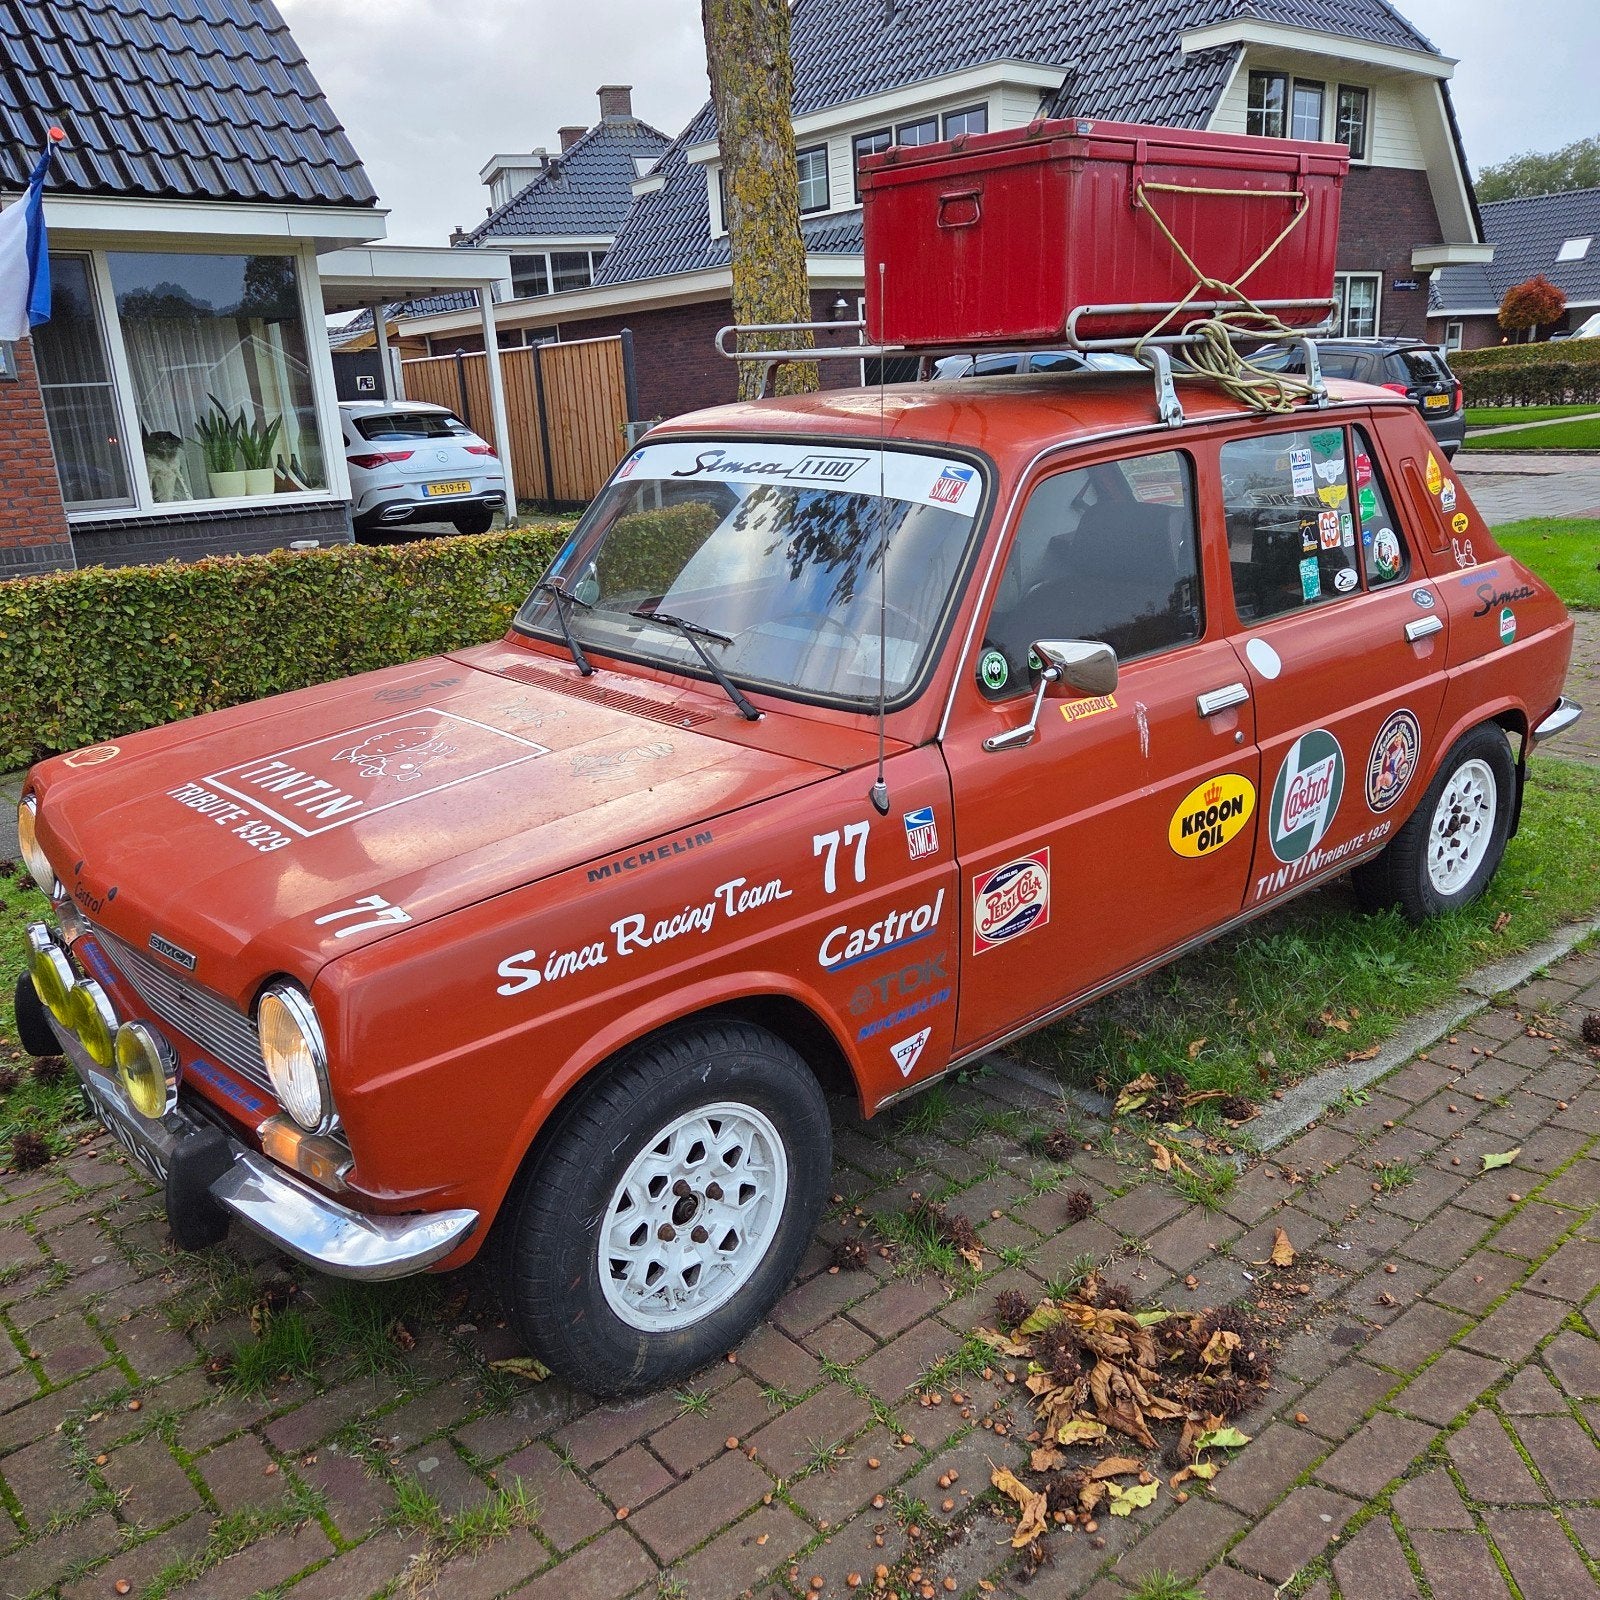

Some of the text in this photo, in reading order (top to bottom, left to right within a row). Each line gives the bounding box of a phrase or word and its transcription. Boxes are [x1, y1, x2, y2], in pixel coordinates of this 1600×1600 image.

[671, 449, 855, 477] Simca 1100
[930, 478, 966, 502] SIMCA
[1473, 583, 1535, 618] Simca
[240, 760, 364, 819] TINTIN
[1182, 793, 1244, 839] KROON
[1283, 759, 1334, 833] Castrol
[166, 782, 292, 852] TRIBUTE 1929
[907, 825, 938, 857] SIMCA
[1197, 824, 1224, 851] OIL
[586, 830, 714, 883] MICHELIN
[813, 819, 870, 894] 77
[1256, 820, 1392, 900] TINTIN TRIBUTE 1929
[314, 894, 413, 939] 77
[497, 876, 793, 996] Simca Racing Team
[818, 887, 945, 967] Castrol
[151, 938, 191, 967] SIMCA
[872, 951, 948, 1004] TDK
[857, 987, 951, 1042] MICHELIN
